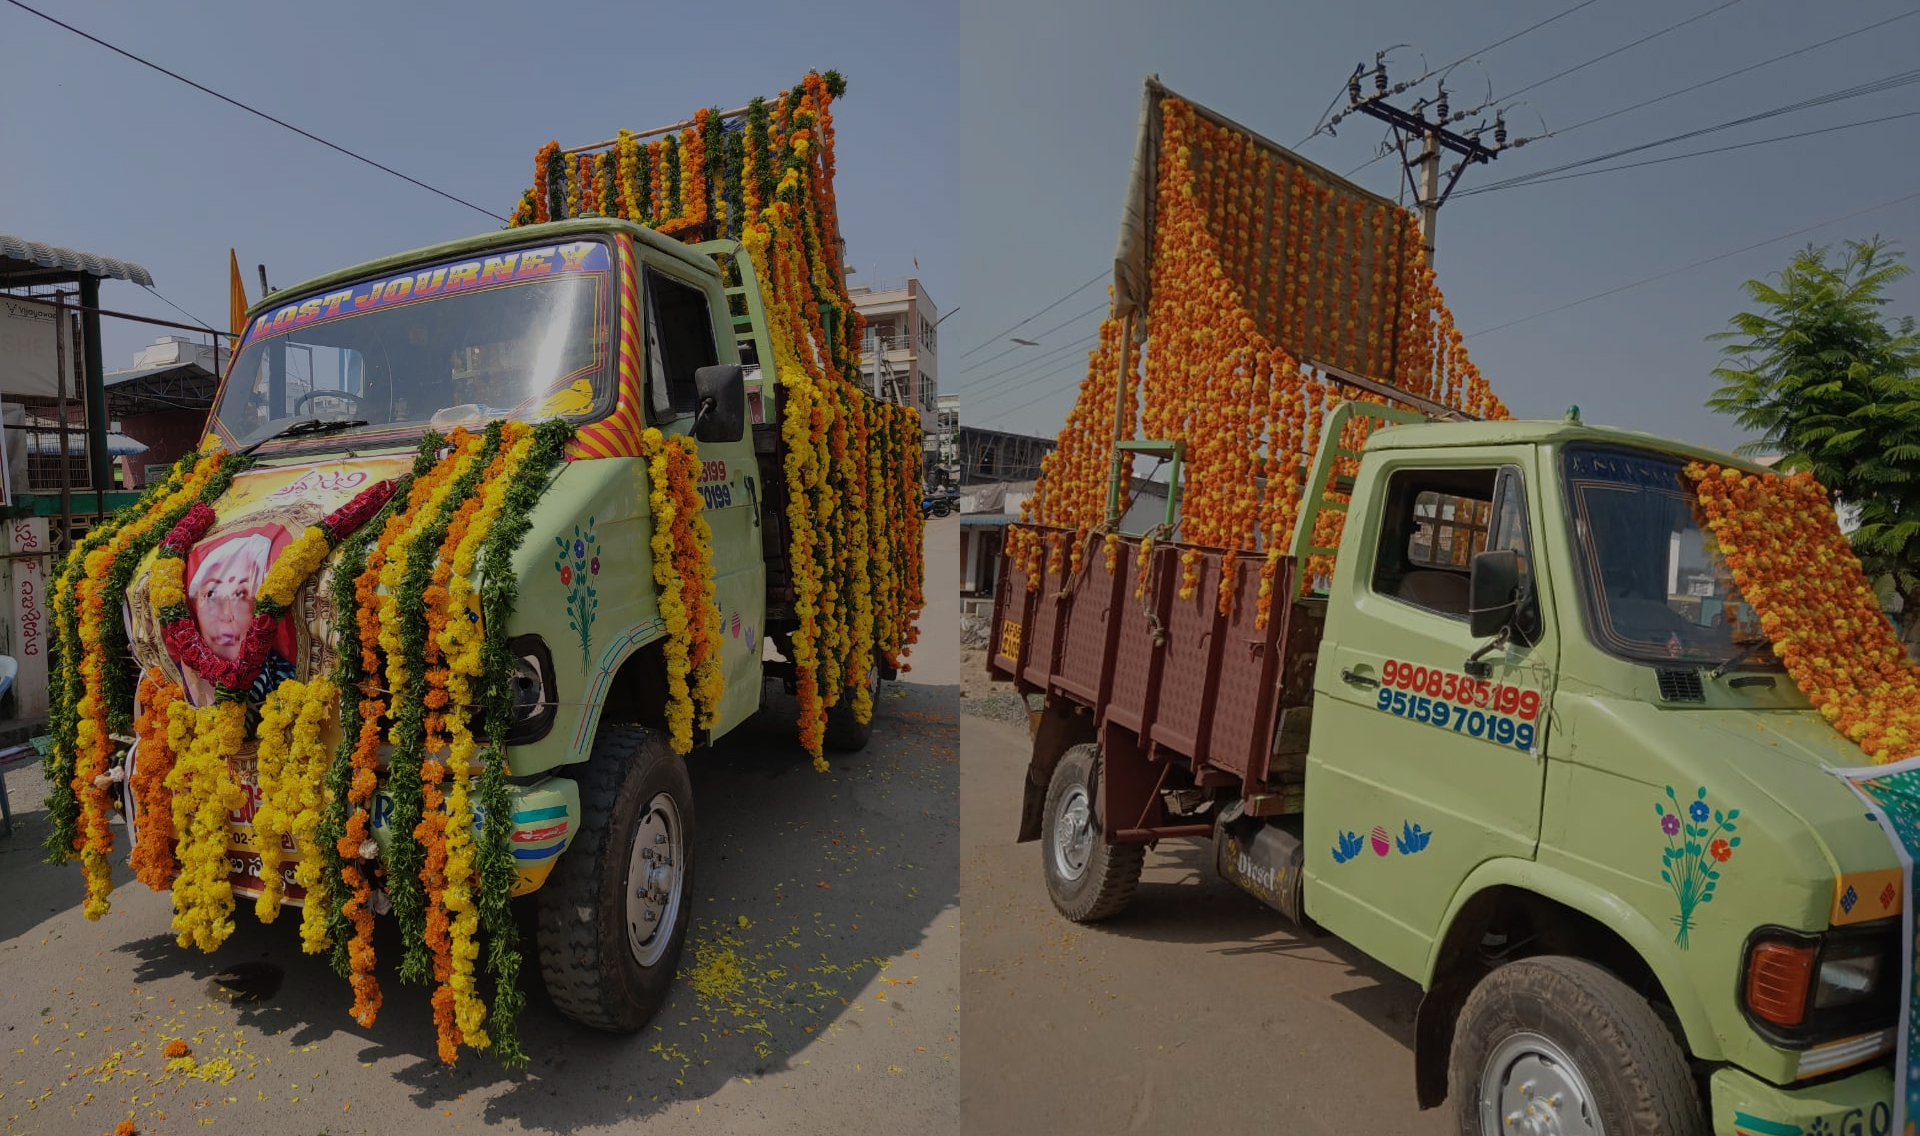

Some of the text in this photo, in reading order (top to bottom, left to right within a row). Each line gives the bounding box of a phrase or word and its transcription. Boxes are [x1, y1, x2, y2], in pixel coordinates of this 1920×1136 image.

[251, 241, 597, 339] LOST JOURNEY
[1377, 687, 1534, 751] 9515970199
[1382, 659, 1540, 721] 9908385199
[1237, 850, 1276, 892] Diesel
